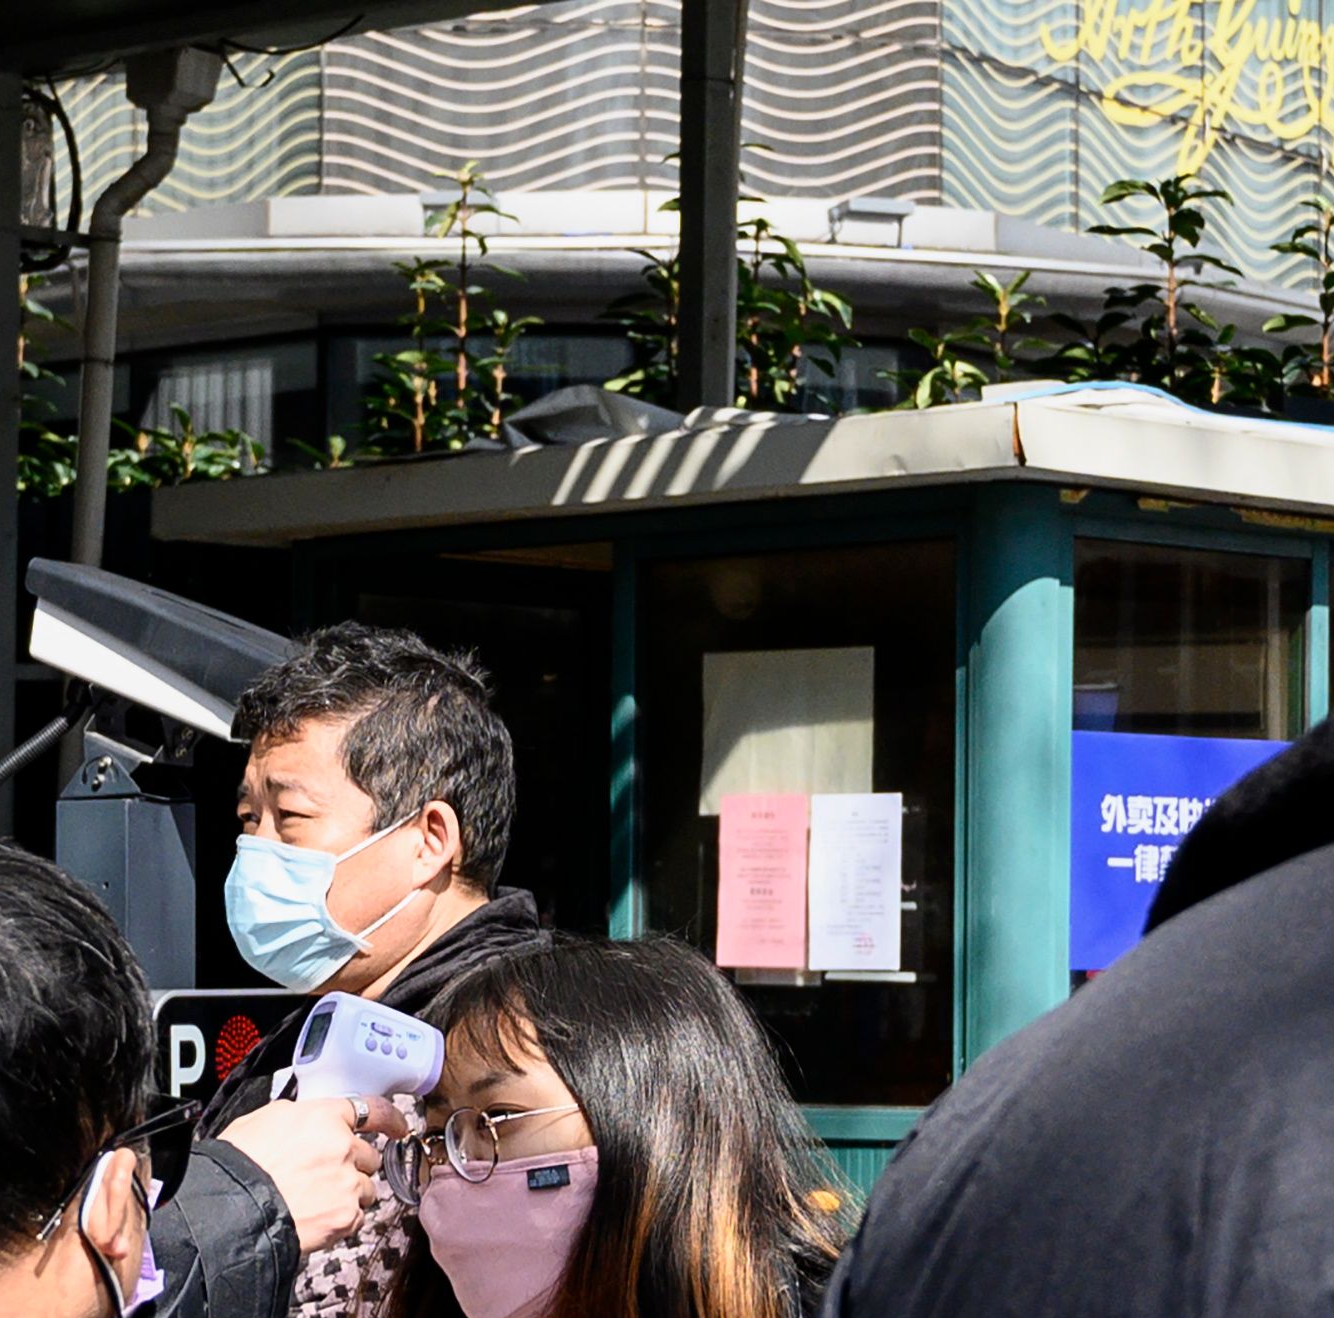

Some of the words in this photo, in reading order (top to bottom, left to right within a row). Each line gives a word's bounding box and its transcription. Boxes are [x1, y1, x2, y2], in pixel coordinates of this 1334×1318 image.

[1100, 793, 1216, 836] 外卖及快
[169, 1023, 206, 1097] P
